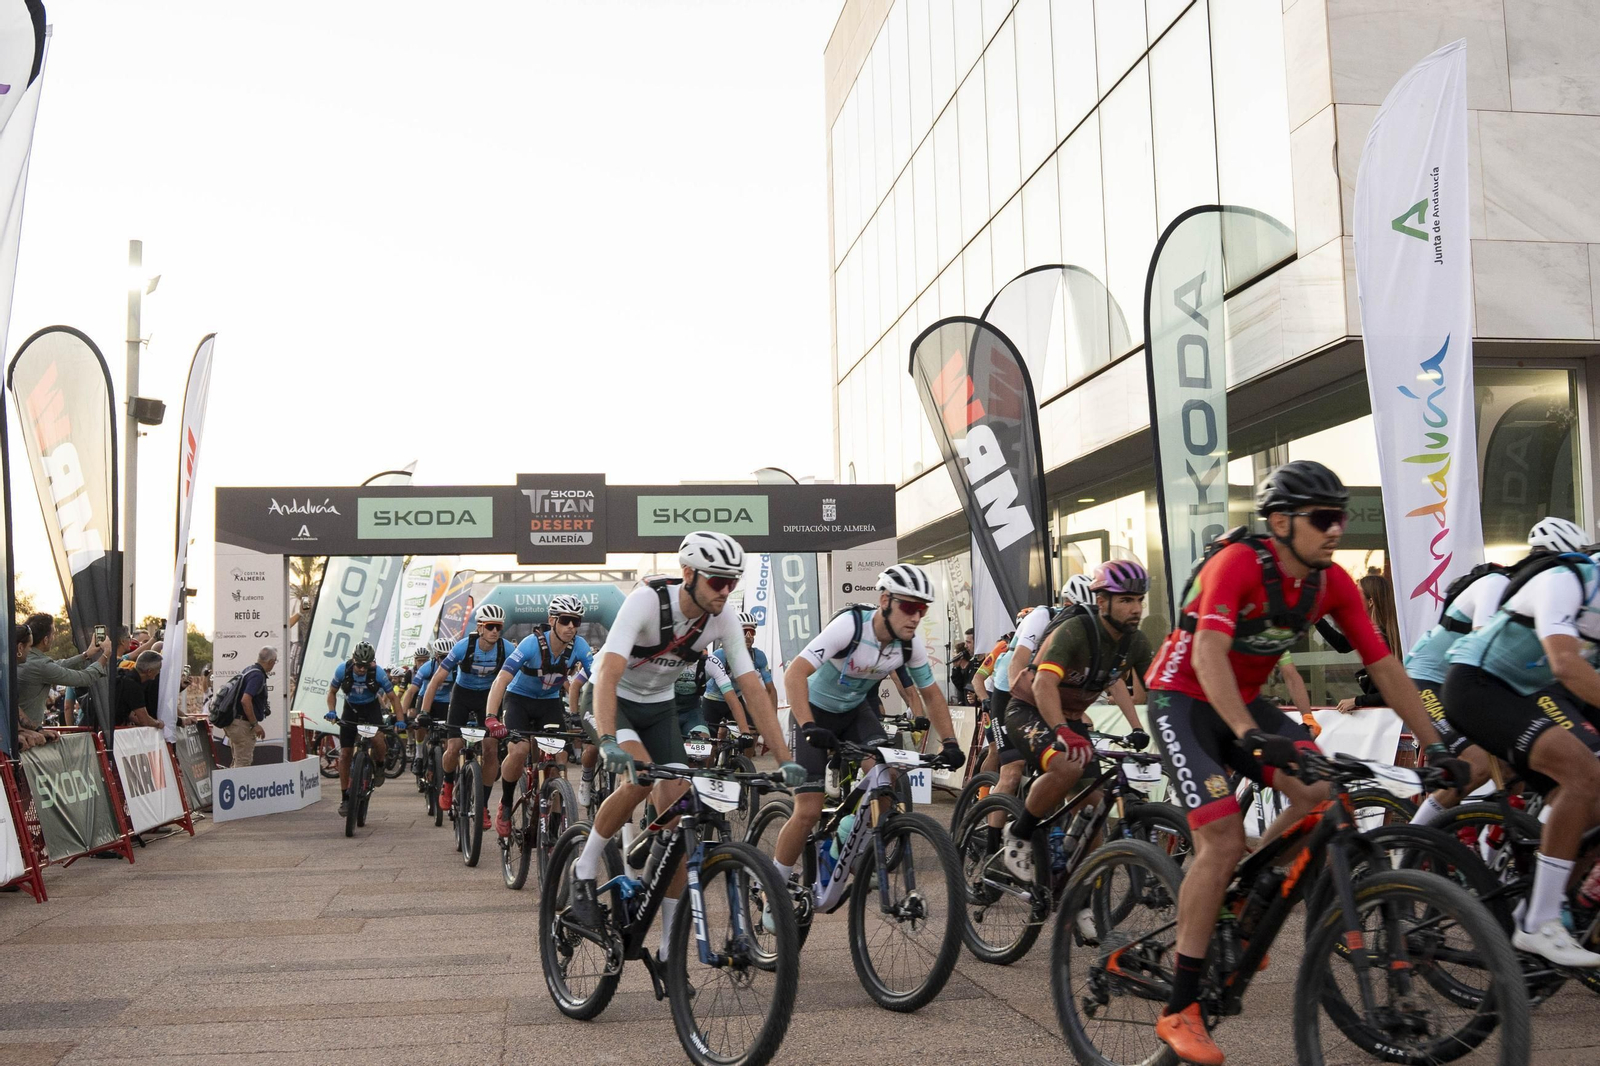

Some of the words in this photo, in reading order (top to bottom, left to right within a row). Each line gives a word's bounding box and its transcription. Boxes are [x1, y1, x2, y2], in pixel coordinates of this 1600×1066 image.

[1430, 166, 1440, 218] Andalucía
[1432, 220, 1441, 233] de
[1434, 235, 1443, 265] Junta
[1397, 332, 1453, 610] Andalucía
[268, 497, 341, 516] Andalucía
[531, 519, 594, 530] DESERT
[783, 524, 830, 532] DIPUTACIÓN
[843, 523, 876, 532] ALMERÍA
[539, 533, 584, 543] ALMERÍA
[304, 676, 329, 687] SKO
[1157, 714, 1201, 809] MOROCCO
[238, 779, 294, 801] Cleardent
[709, 780, 725, 793] 38
